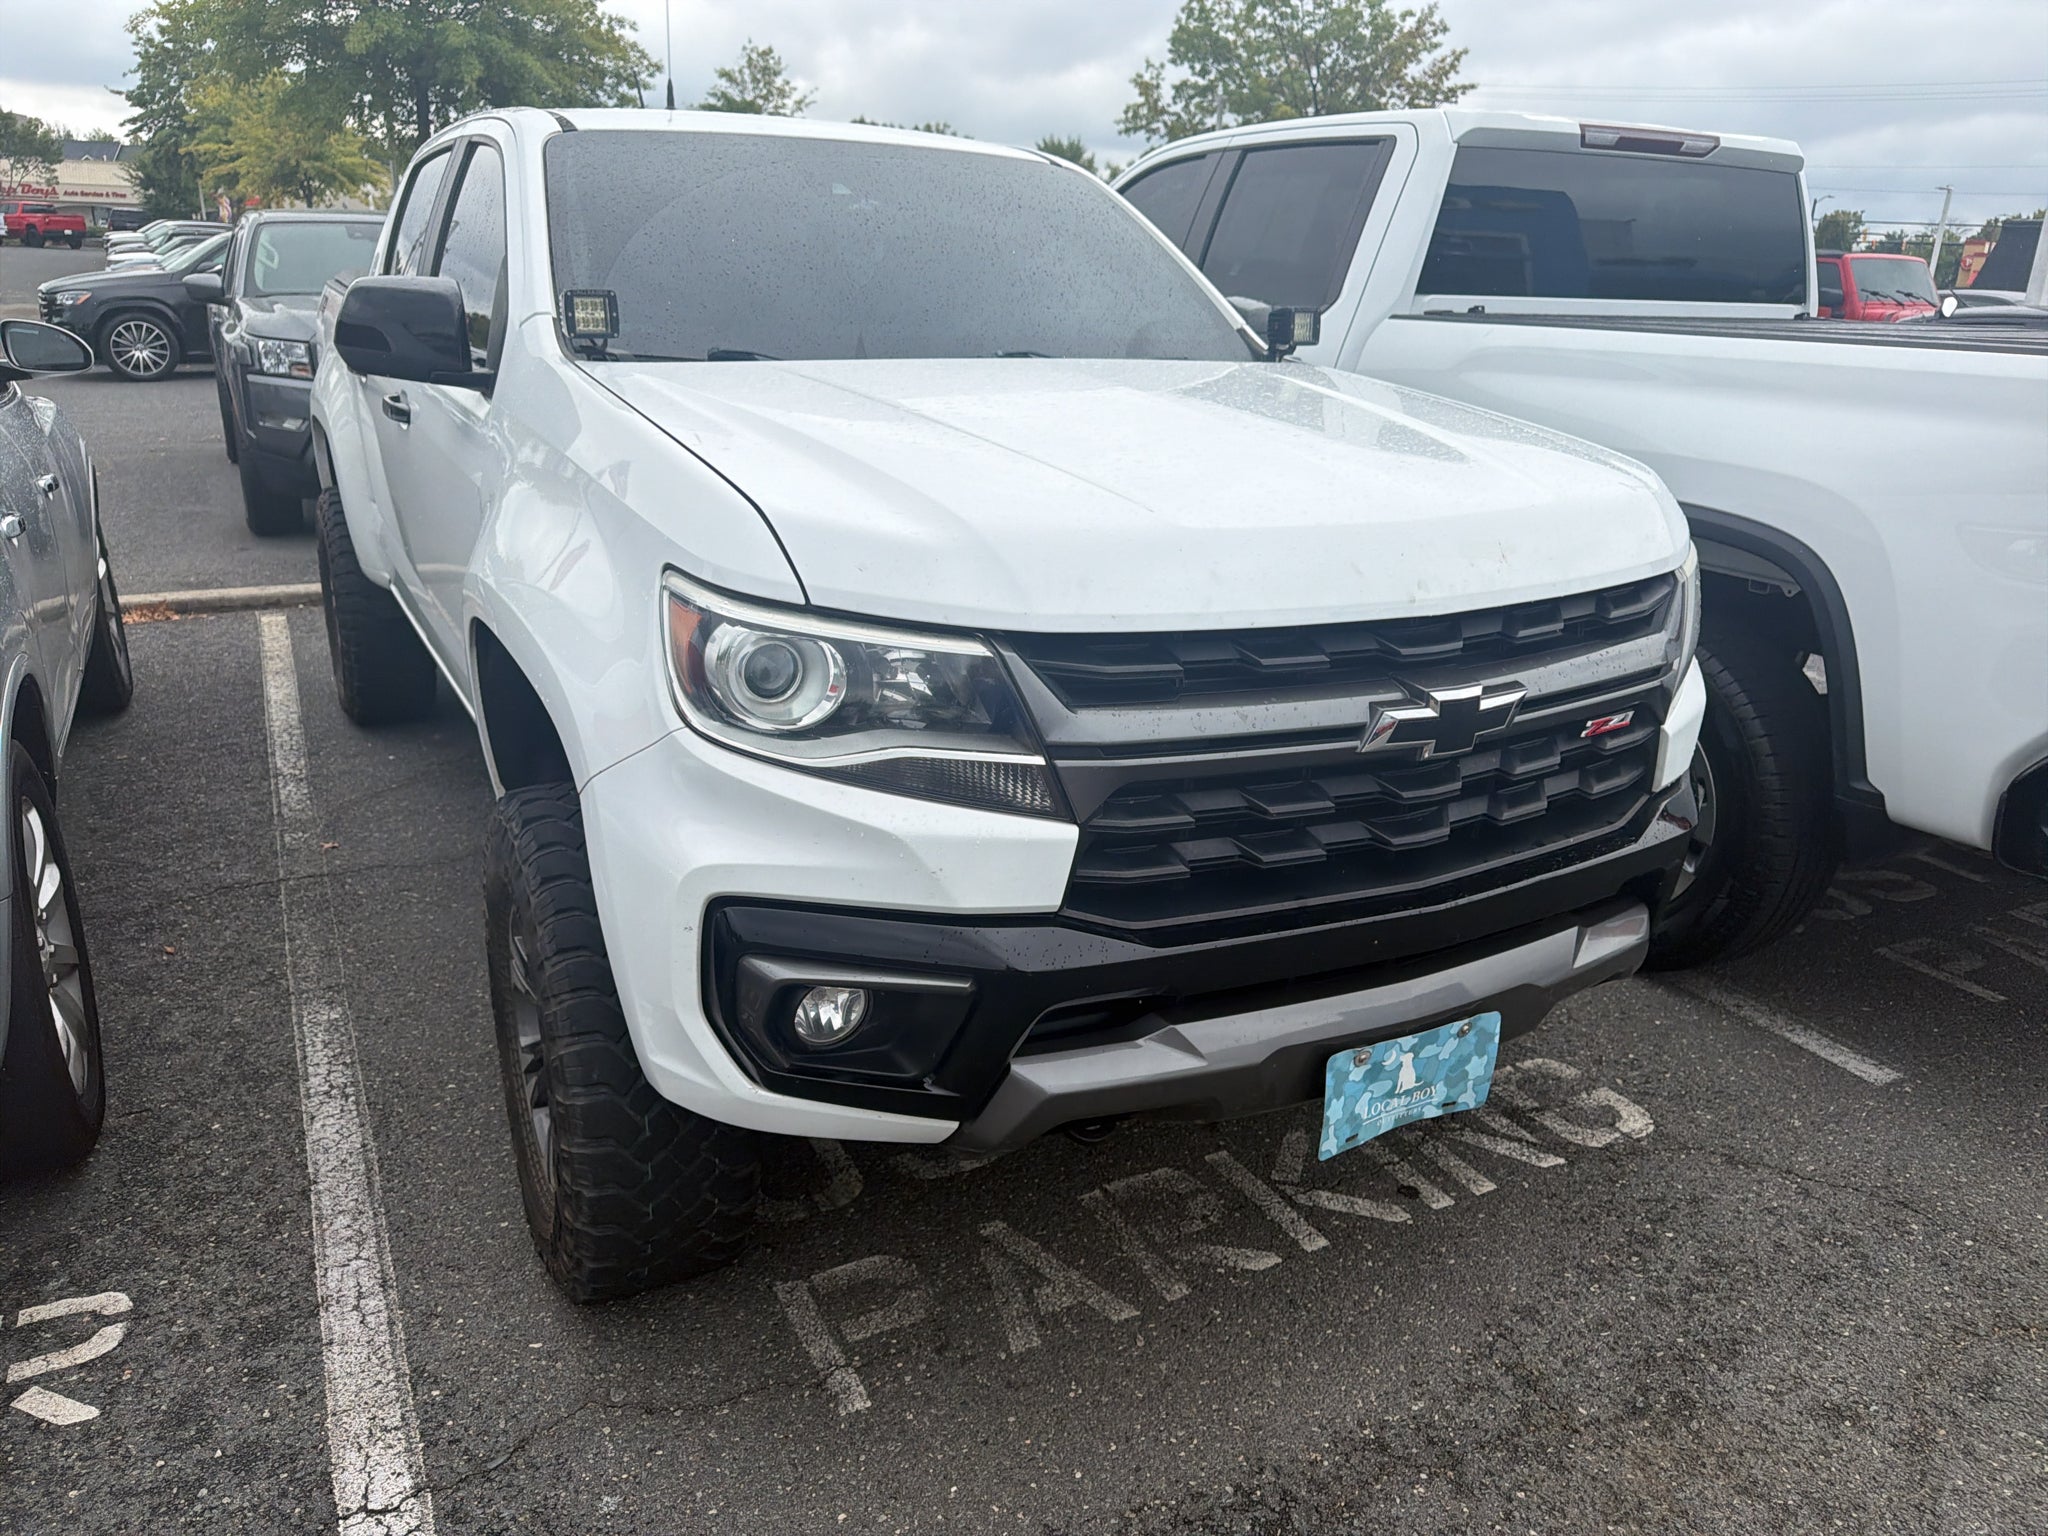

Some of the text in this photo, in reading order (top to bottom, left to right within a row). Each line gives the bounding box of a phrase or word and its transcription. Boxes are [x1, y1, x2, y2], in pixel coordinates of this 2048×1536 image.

[21, 184, 59, 198] Boys
[1362, 1084, 1438, 1120] LOCAL BOY
